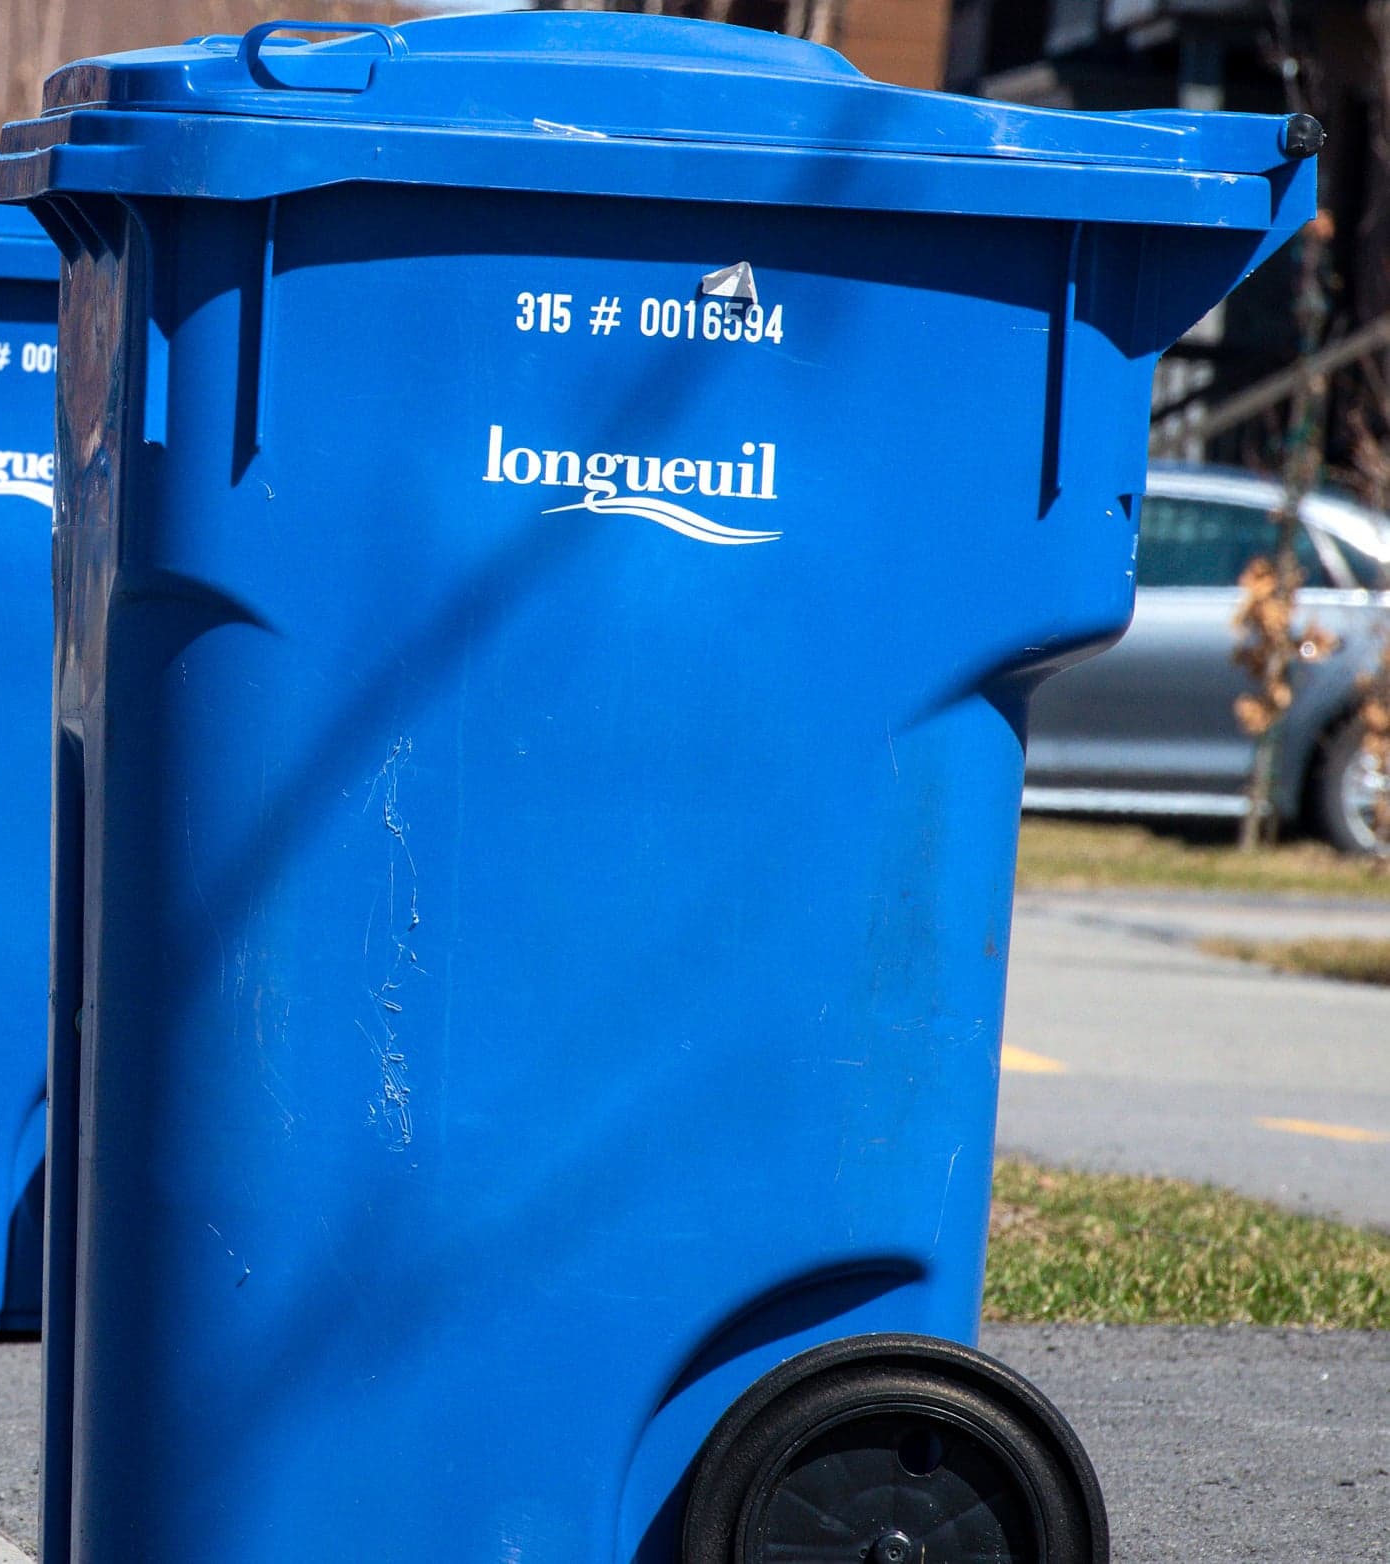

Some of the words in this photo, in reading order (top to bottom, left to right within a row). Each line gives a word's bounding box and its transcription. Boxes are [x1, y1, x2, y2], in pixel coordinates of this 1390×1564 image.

[516, 292, 572, 334] 315
[589, 296, 622, 336] #
[640, 298, 784, 344] 0016594
[482, 424, 778, 513] longueuil
